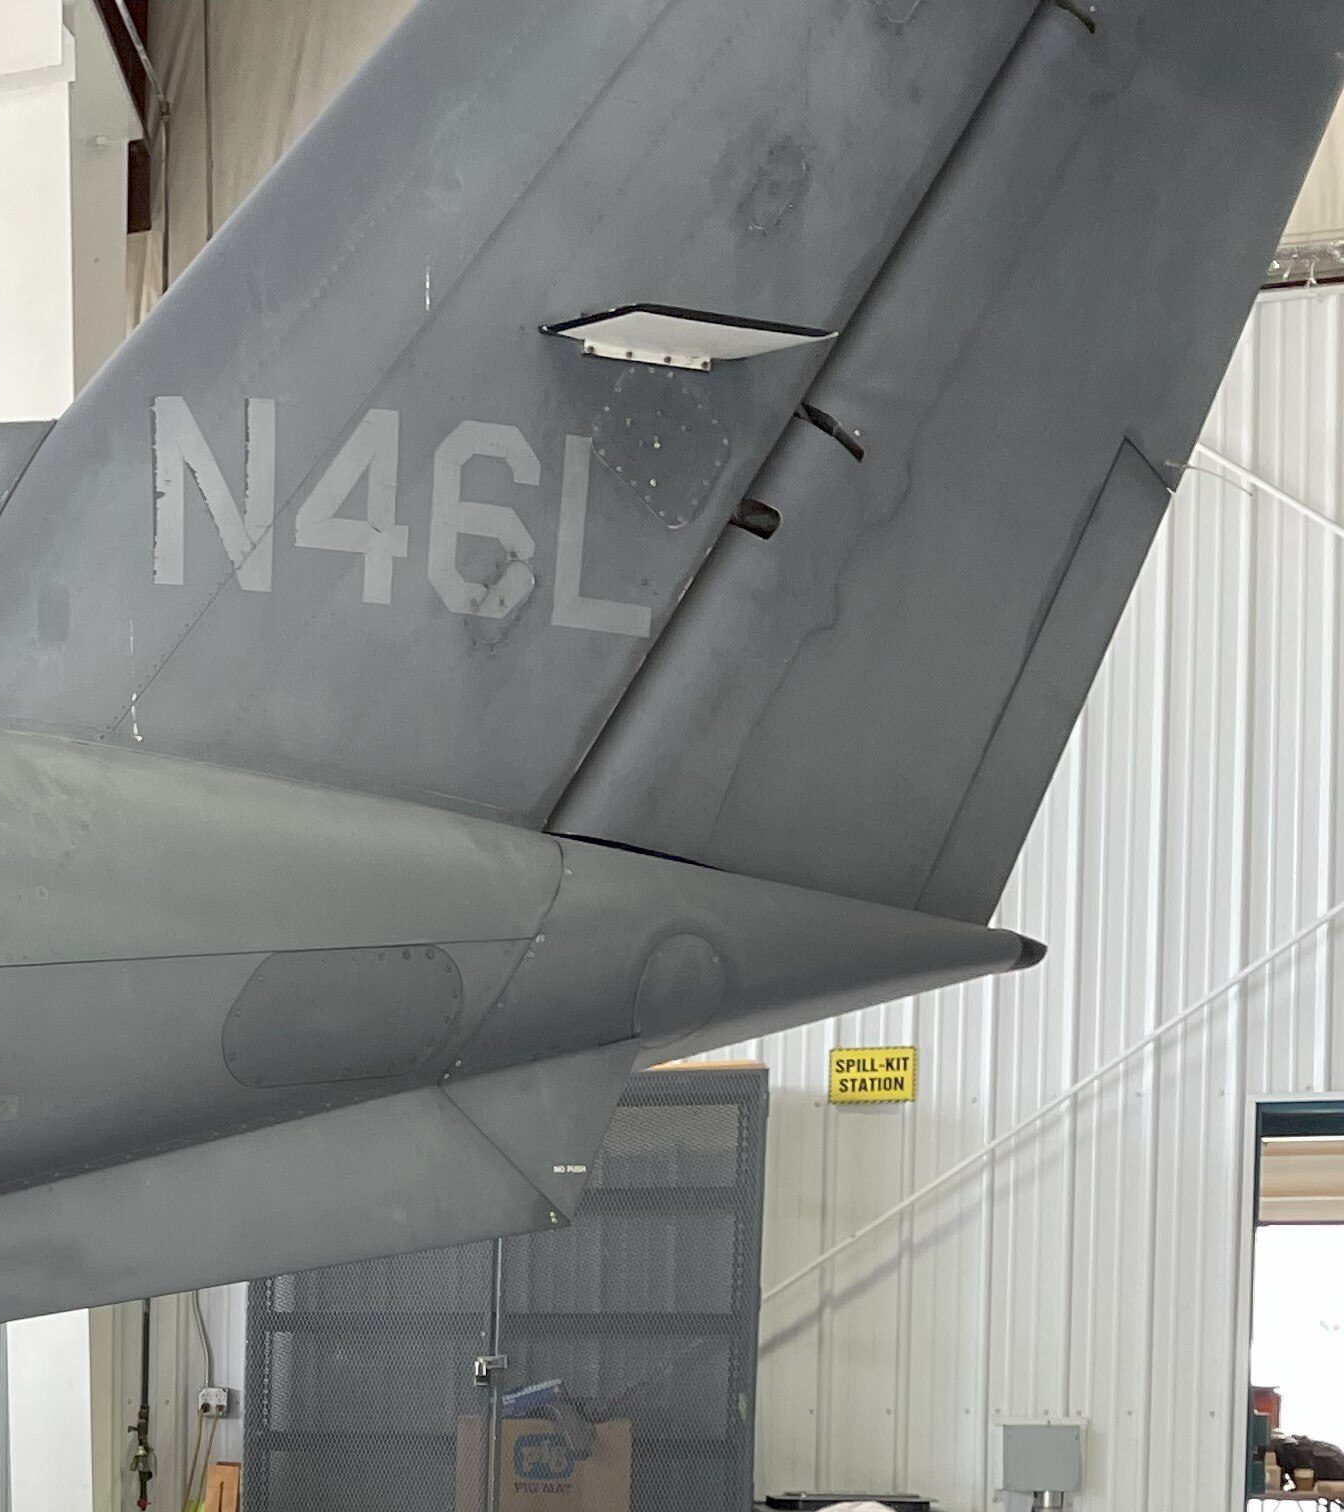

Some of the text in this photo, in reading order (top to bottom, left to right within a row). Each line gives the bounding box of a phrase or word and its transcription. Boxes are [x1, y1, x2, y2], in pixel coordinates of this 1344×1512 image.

[152, 395, 652, 638] N46L
[835, 1057, 910, 1073] SPILL-KIT
[839, 1077, 905, 1093] STATION
